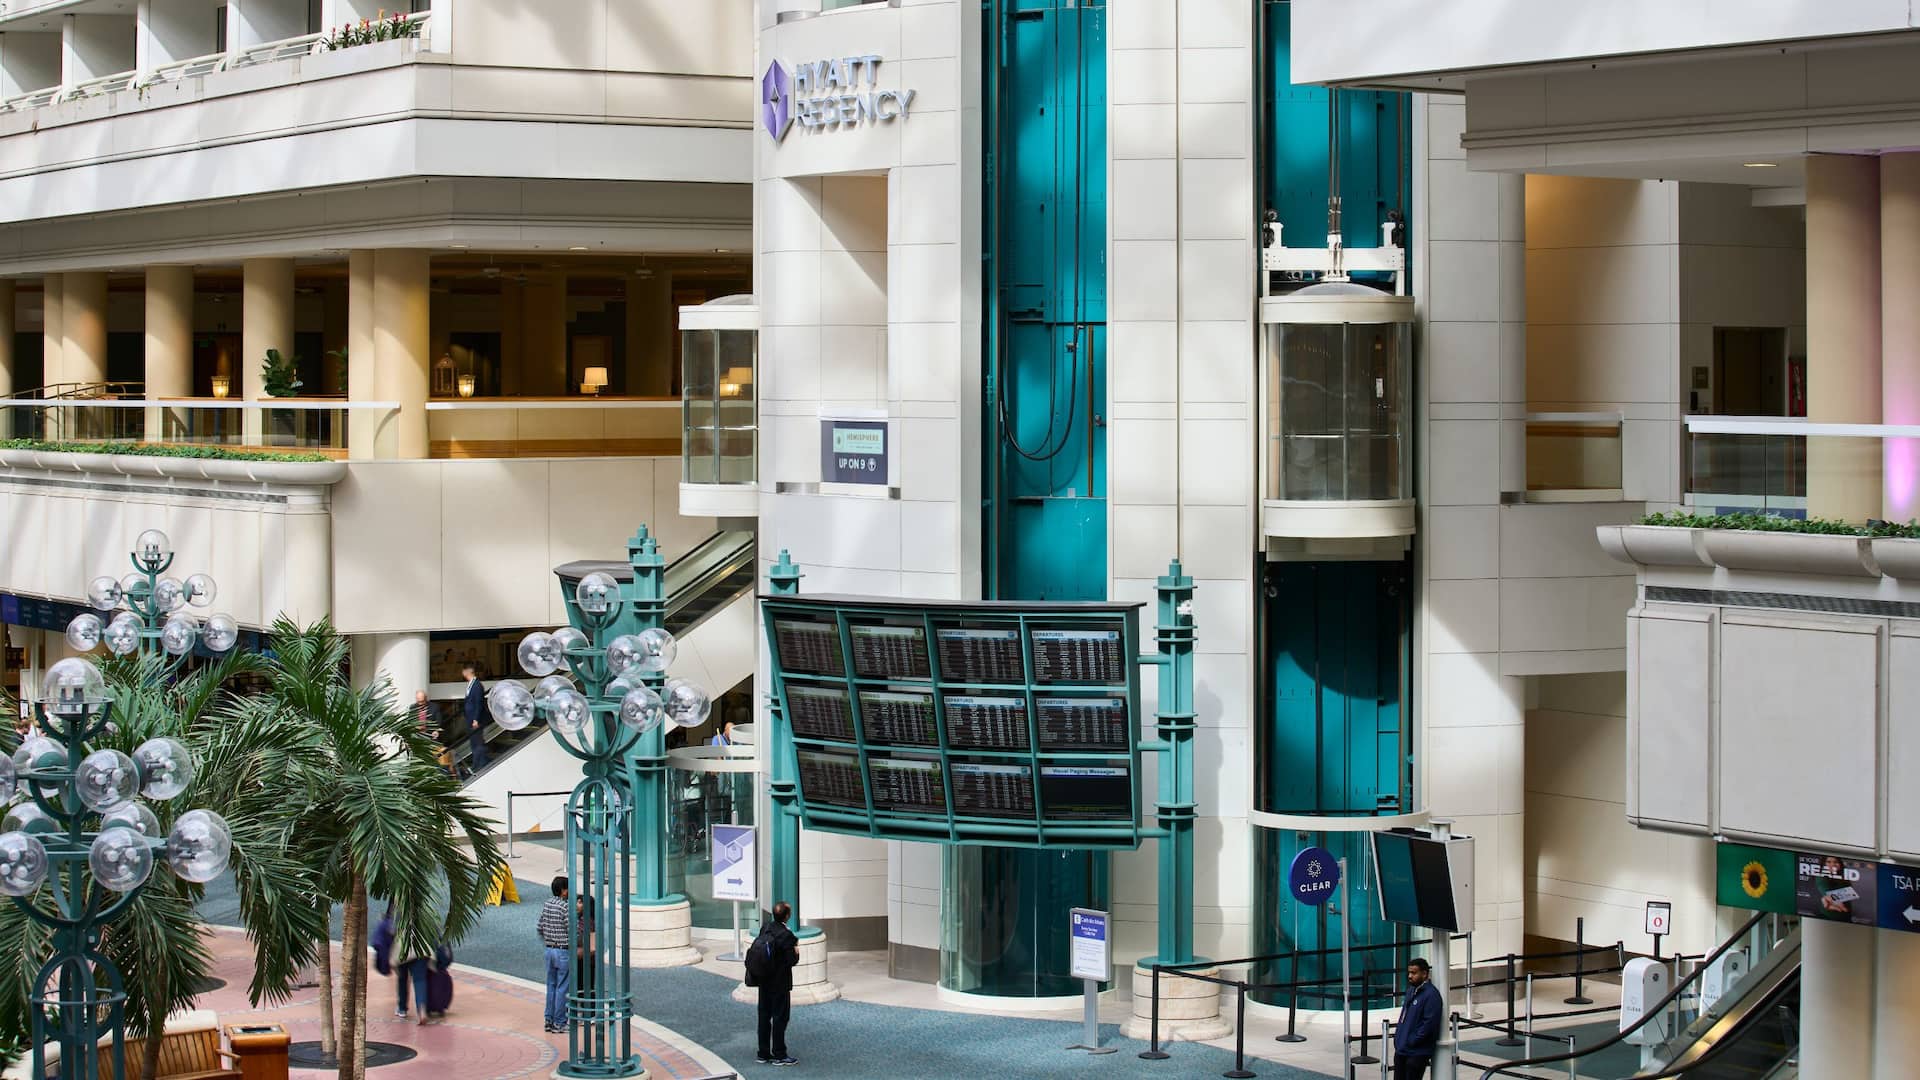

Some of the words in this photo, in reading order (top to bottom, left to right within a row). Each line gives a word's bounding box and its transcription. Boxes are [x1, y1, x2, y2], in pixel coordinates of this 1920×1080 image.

[796, 55, 882, 92] HYATT
[796, 89, 915, 126] REGENCY
[838, 458, 847, 469] UP
[848, 458, 860, 470] ON
[860, 459, 866, 470] 9
[1799, 862, 1842, 880] REAL
[1843, 868, 1860, 882] ID
[1300, 881, 1331, 892] CLEAR
[1892, 875, 1914, 891] TSA
